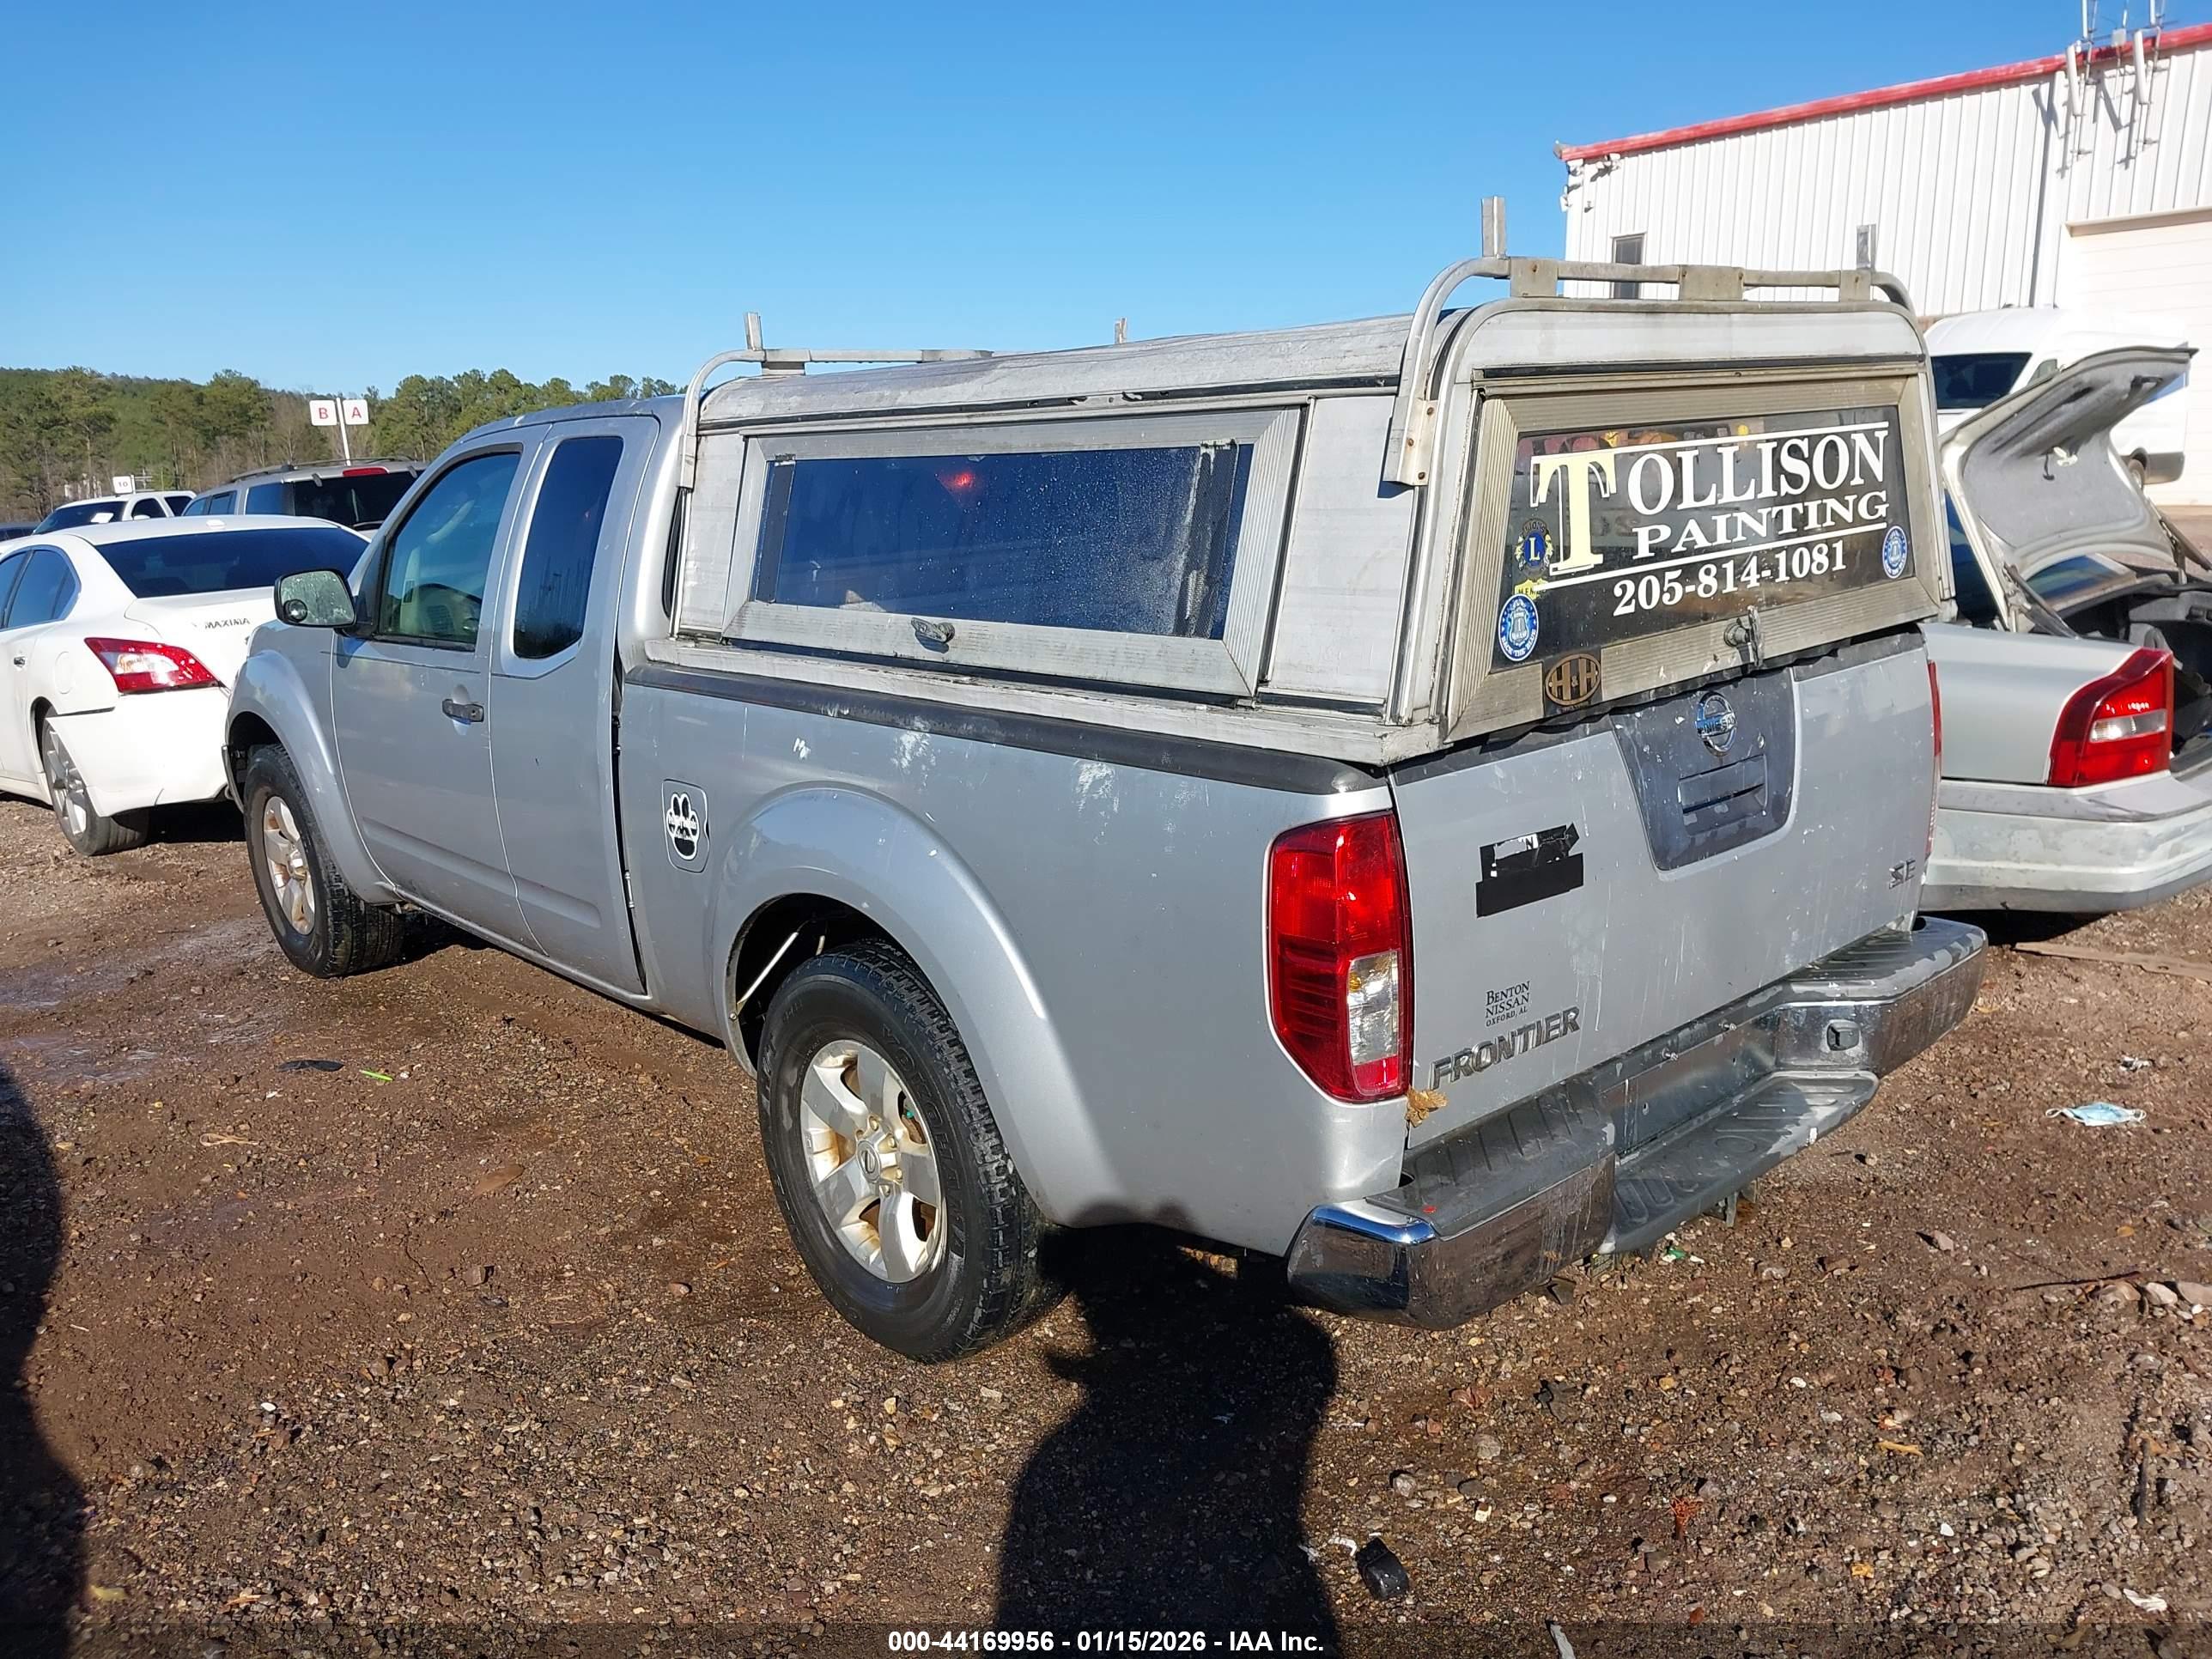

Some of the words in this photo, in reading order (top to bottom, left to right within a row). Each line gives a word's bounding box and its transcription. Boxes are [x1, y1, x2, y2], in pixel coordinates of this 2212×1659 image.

[319, 407, 329, 419] B
[351, 406, 362, 418] A
[1530, 430, 1888, 576] TOLLISON
[1523, 520, 1546, 532] LIONS
[1632, 490, 1889, 561] PAINTING
[1528, 537, 1540, 562] L
[1613, 539, 1846, 617] 205-814-1081
[205, 617, 251, 629] MAXIMA
[1889, 860, 1916, 890] SE
[1486, 993, 1529, 1018] NISSAN
[1486, 1011, 1517, 1027] OXFORD,
[1519, 1006, 1528, 1015] AL
[1428, 1006, 1580, 1090] FRONTIER
